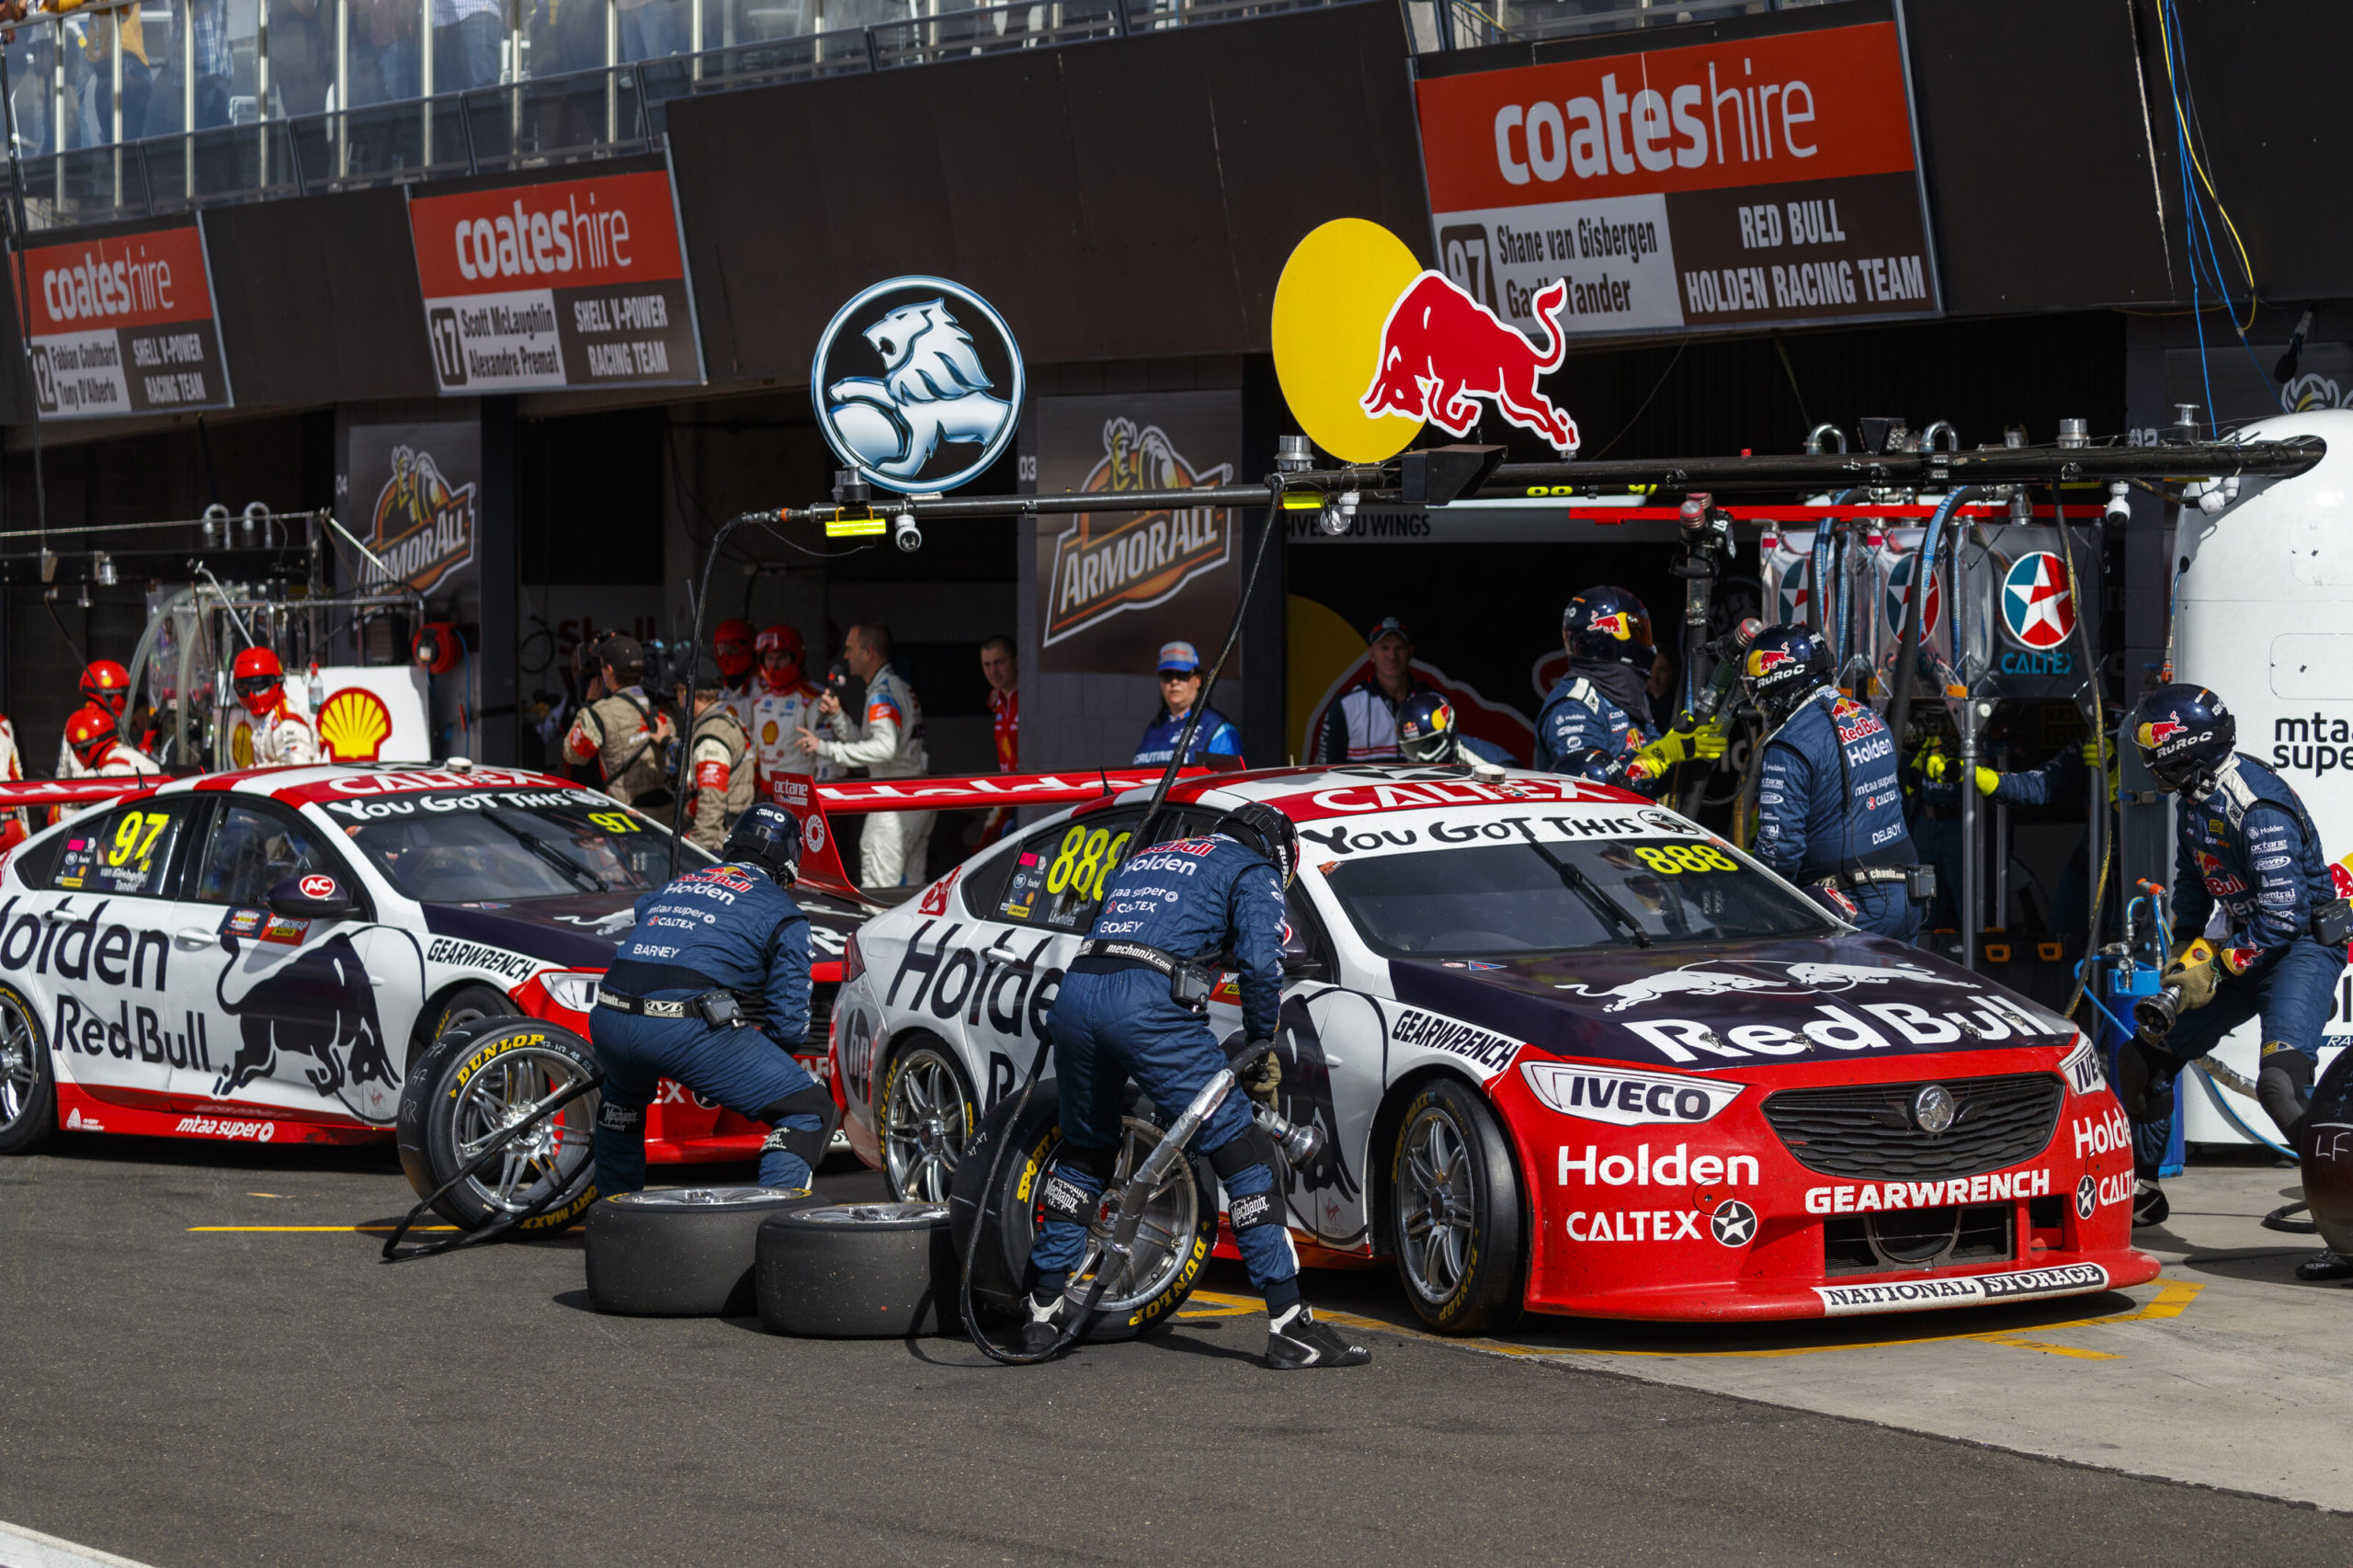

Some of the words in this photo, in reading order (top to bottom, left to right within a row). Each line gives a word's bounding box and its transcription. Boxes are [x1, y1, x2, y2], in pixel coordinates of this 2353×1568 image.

[1739, 204, 1783, 249] RED
[1787, 199, 1846, 246] BULL
[1497, 224, 1543, 266] Shane
[1546, 227, 1574, 261] van
[1578, 216, 1658, 264] Gisbergen
[1684, 266, 1770, 314] HOLDEN
[1774, 257, 1857, 309] RACING
[1858, 256, 1927, 302] TEAM
[460, 307, 489, 339] Scott
[490, 301, 555, 341] McLaughlin
[574, 299, 612, 334] SHELL
[609, 294, 669, 330] V-POWER
[50, 344, 80, 373] Fabian
[79, 340, 119, 369] Coulthard
[132, 337, 162, 367] SHELL
[159, 333, 204, 365] V-POWER
[434, 318, 460, 376] 17
[468, 347, 520, 380] Alexandre
[519, 344, 561, 375] Premat
[586, 343, 633, 377] RACING
[631, 340, 670, 374] TEAM
[33, 352, 55, 404] 12
[144, 375, 179, 405] RACING
[176, 372, 207, 402] TEAM
[57, 378, 80, 412] Tony
[1018, 456, 1038, 482] 03
[1370, 514, 1431, 537] WINGS
[2001, 652, 2078, 676] CALTEX
[1847, 737, 1894, 767] Holden
[774, 779, 809, 797] octane
[1313, 778, 1620, 812] CALTEX
[588, 812, 642, 834] 97
[1872, 823, 1902, 846] DELBOY
[2260, 824, 2284, 835] Holden
[108, 811, 170, 872] 97
[2251, 839, 2287, 851] octane
[1120, 855, 1198, 878] Holden
[1634, 844, 1740, 875] 888
[304, 879, 331, 892] AC
[664, 883, 735, 906] Holden
[2257, 888, 2296, 898] central
[658, 916, 697, 930] CALTEX
[673, 905, 705, 918] super
[0, 895, 170, 992] olden
[426, 937, 538, 982] GEARWRENCH
[633, 943, 680, 959] BARVEY
[1106, 942, 1172, 972] mechanix.com
[1392, 1009, 1519, 1073] GEARWRENCH
[457, 1034, 546, 1087] DUNLOP
[1570, 1076, 1711, 1119] IVECO
[175, 1115, 218, 1133] mtaa
[218, 1119, 260, 1140] super
[2073, 1108, 2131, 1159] Holde
[1017, 1132, 1058, 1203] SPORT
[1558, 1142, 1759, 1186] Holden
[1045, 1177, 1079, 1210] Mechanix
[1805, 1168, 2051, 1214] GEARWRENCH
[1231, 1195, 1270, 1221] Mechanix
[1565, 1210, 1703, 1242] CALTEX
[1128, 1236, 1208, 1327] DUNLOP
[1830, 1278, 1978, 1307] NATIONAL
[1984, 1265, 2100, 1298] STORAGE
